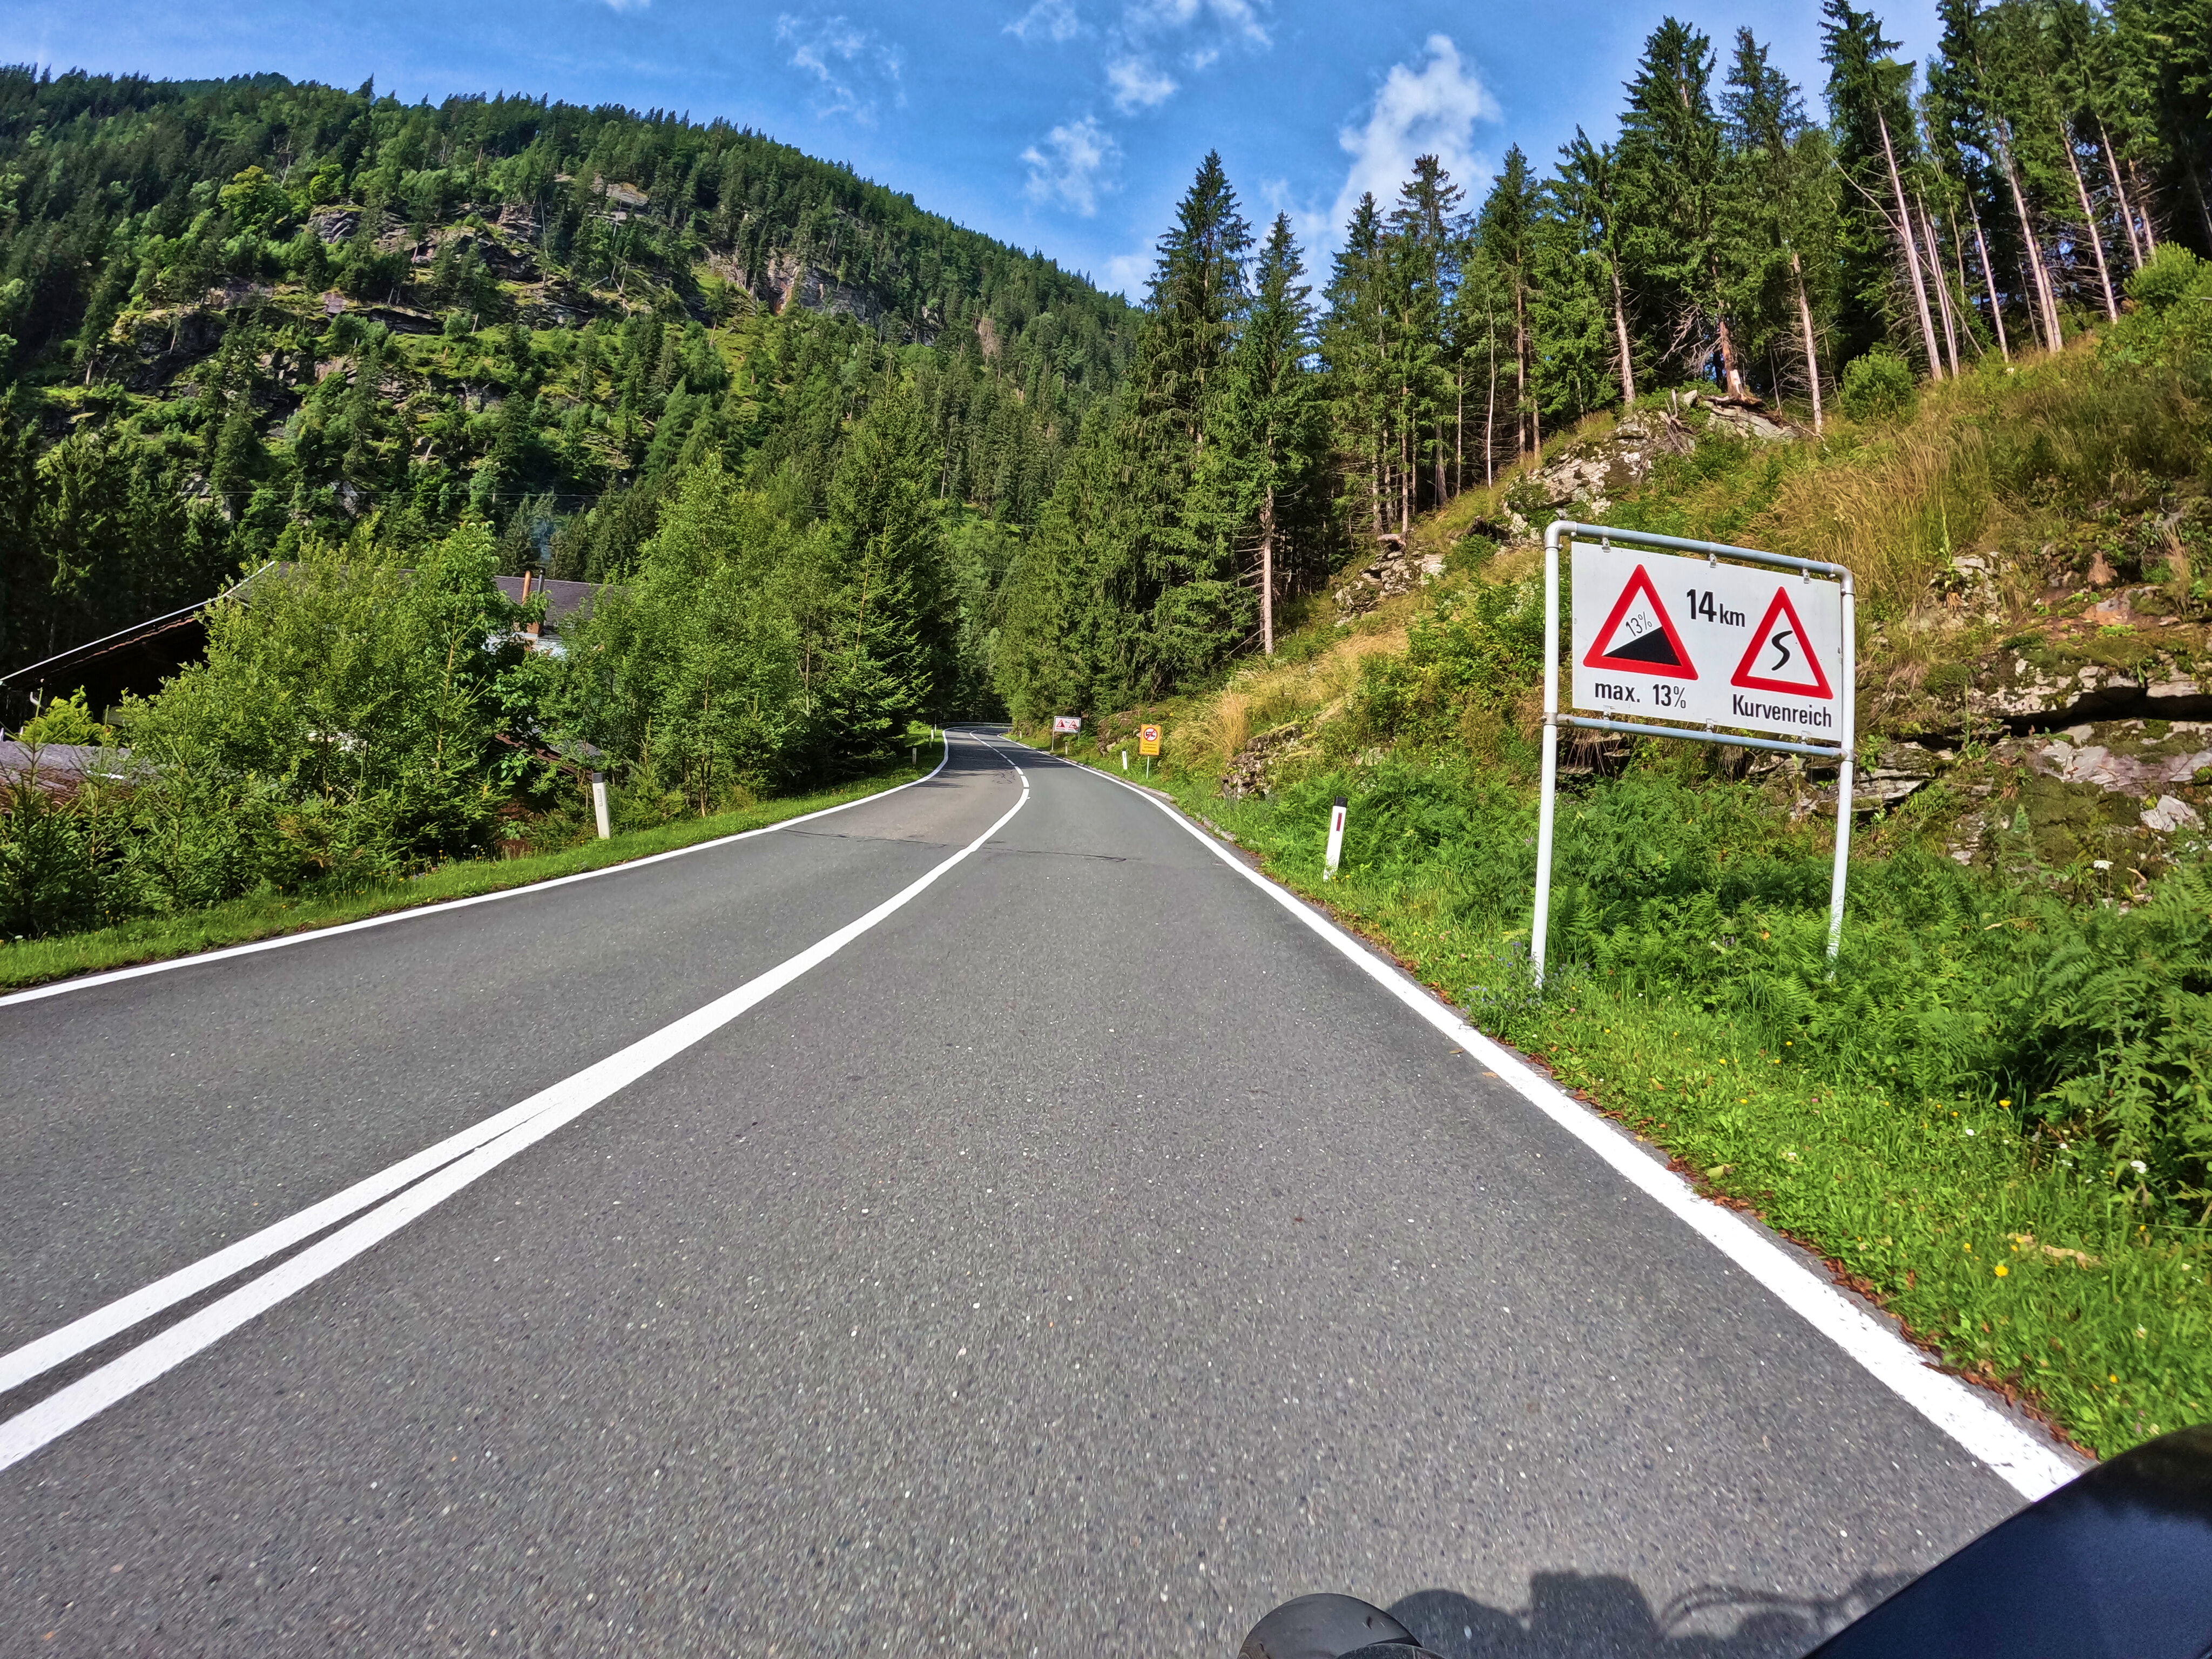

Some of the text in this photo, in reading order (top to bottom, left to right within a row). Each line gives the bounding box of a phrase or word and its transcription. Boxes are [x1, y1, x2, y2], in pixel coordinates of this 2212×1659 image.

[1687, 589, 1745, 628] 14 km
[1626, 611, 1653, 637] 13%
[1595, 683, 1687, 709] max. 13%
[1732, 694, 1832, 727] Kurvenreich
